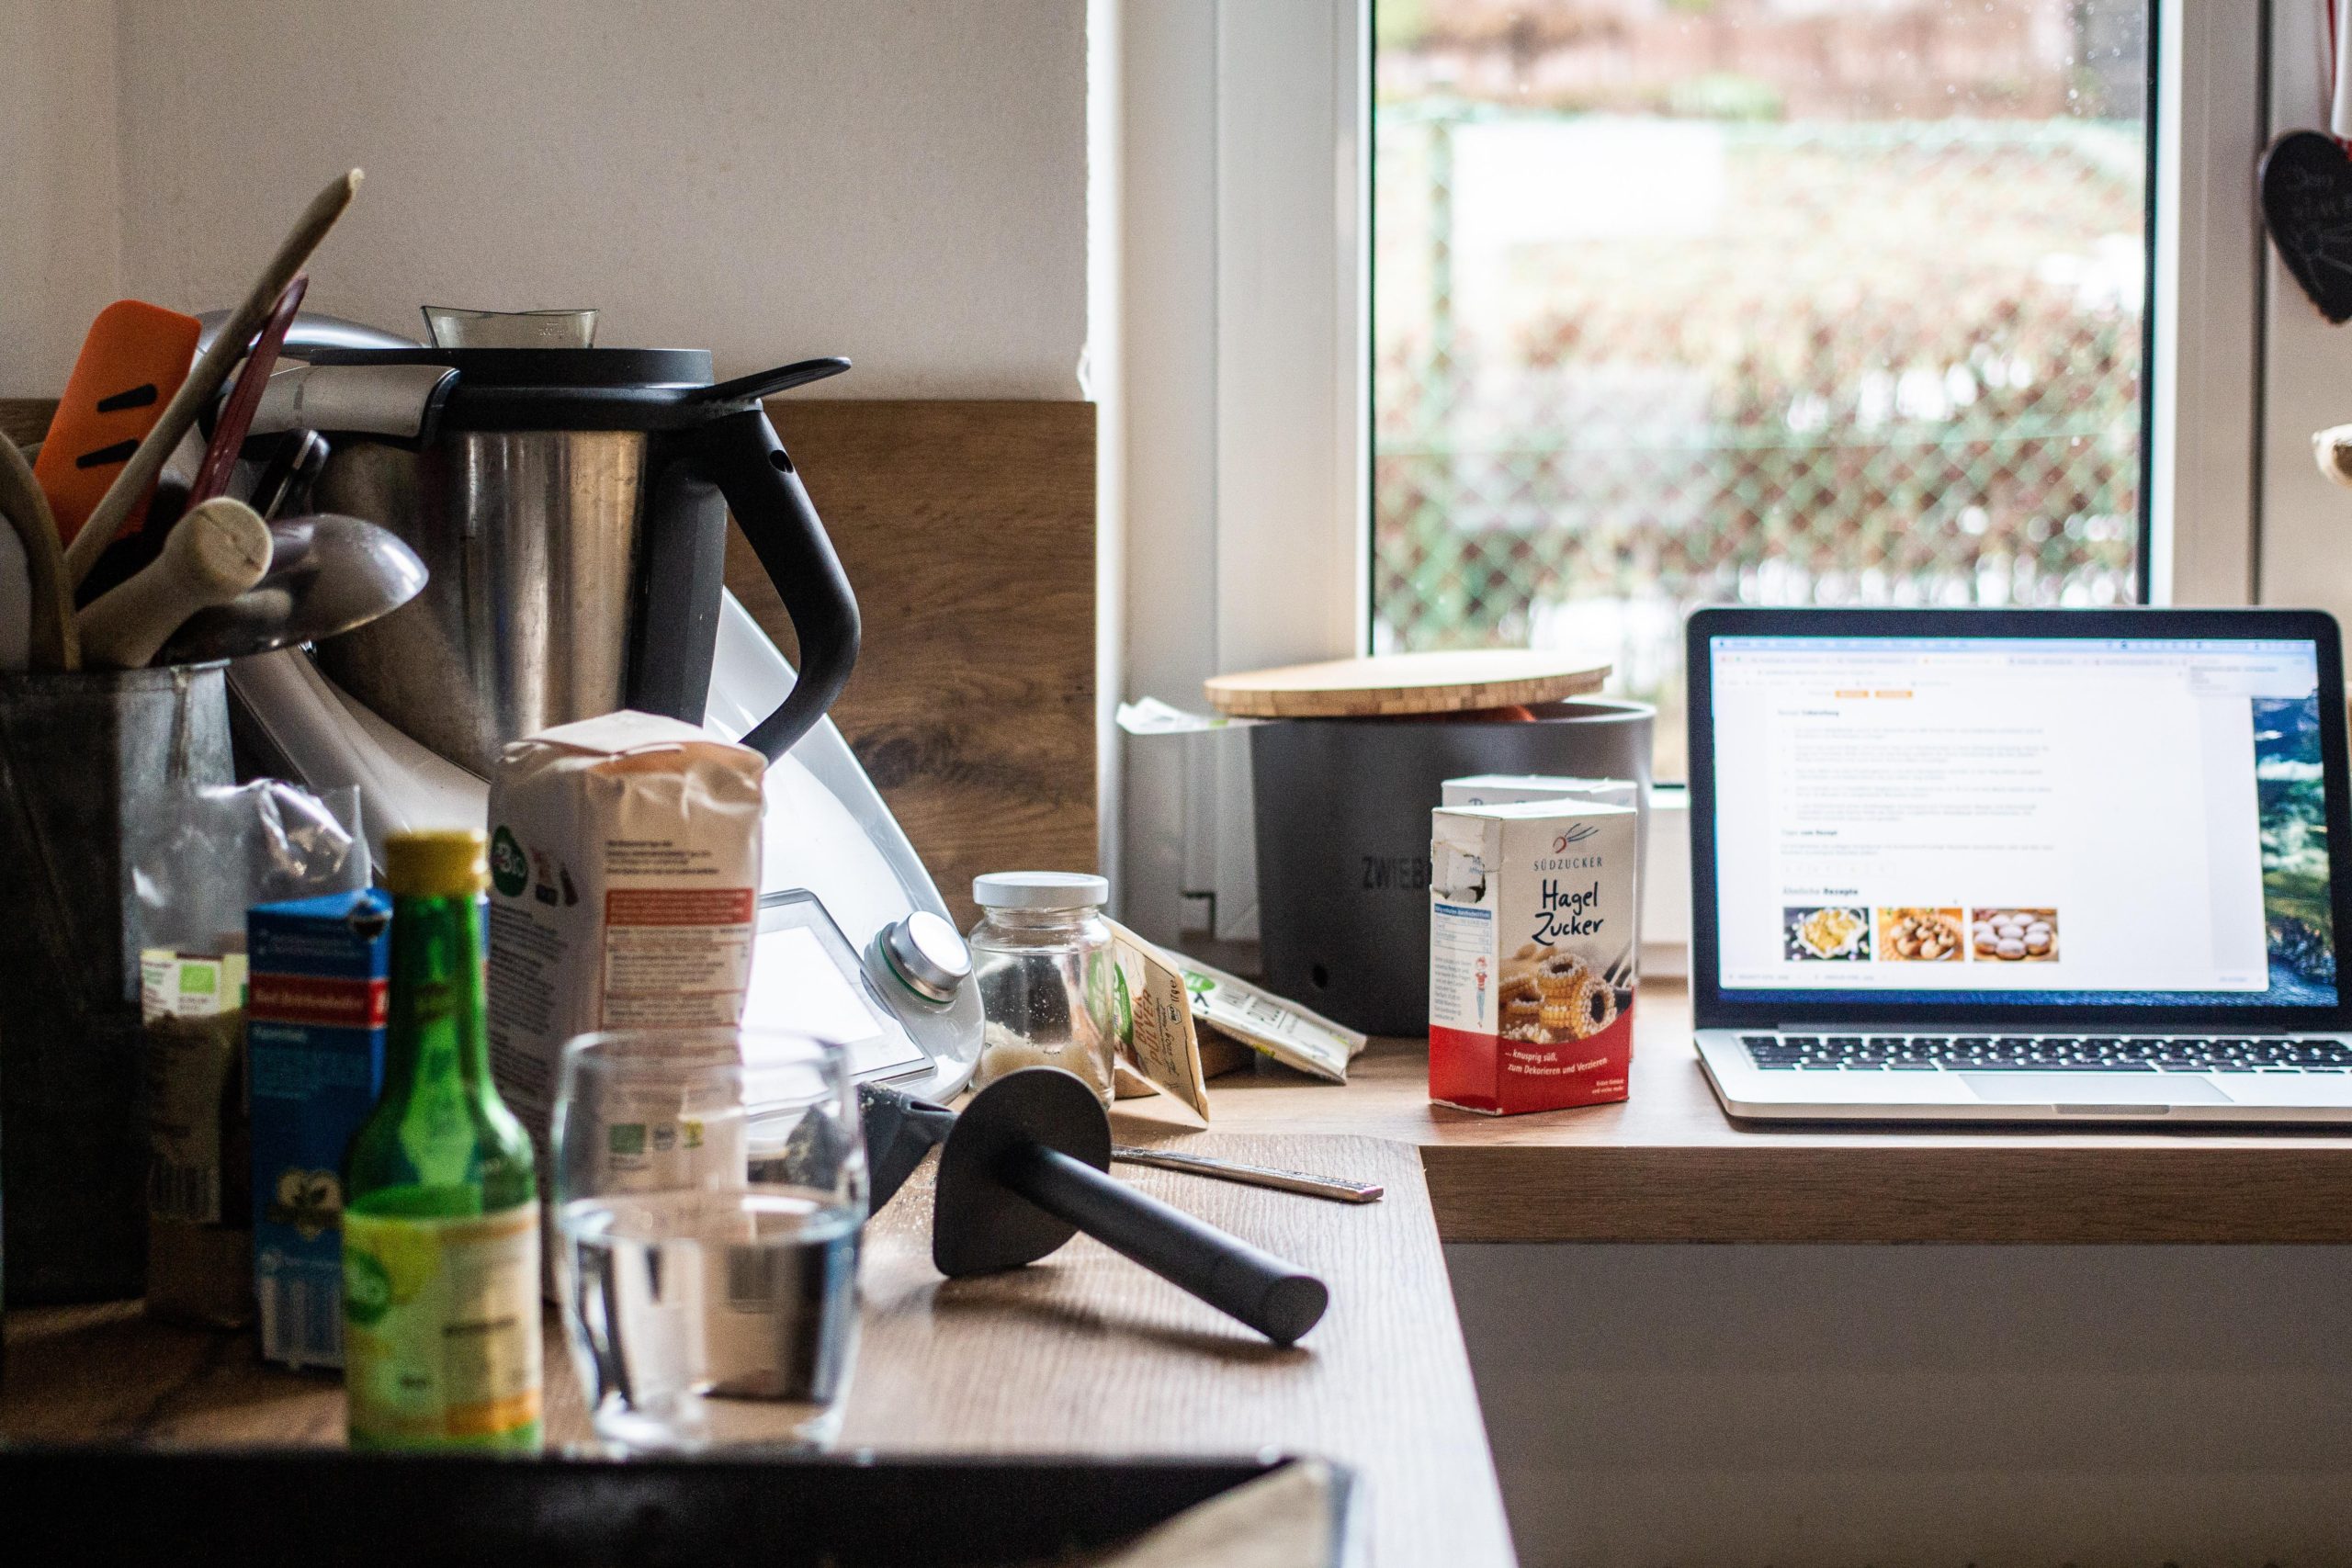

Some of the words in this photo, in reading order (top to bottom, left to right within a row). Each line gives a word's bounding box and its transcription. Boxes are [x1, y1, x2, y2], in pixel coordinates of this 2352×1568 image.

[1532, 856, 1603, 871] SÜDZUCKER
[1542, 879, 1599, 916] Hagel
[1531, 912, 1604, 946] Zucker
[1512, 1049, 1542, 1064] knusprig
[1508, 1064, 1522, 1073] zum
[1524, 1065, 1561, 1075] Dekorieren
[1562, 1064, 1576, 1074] und
[1577, 1057, 1608, 1071] Verzieren
